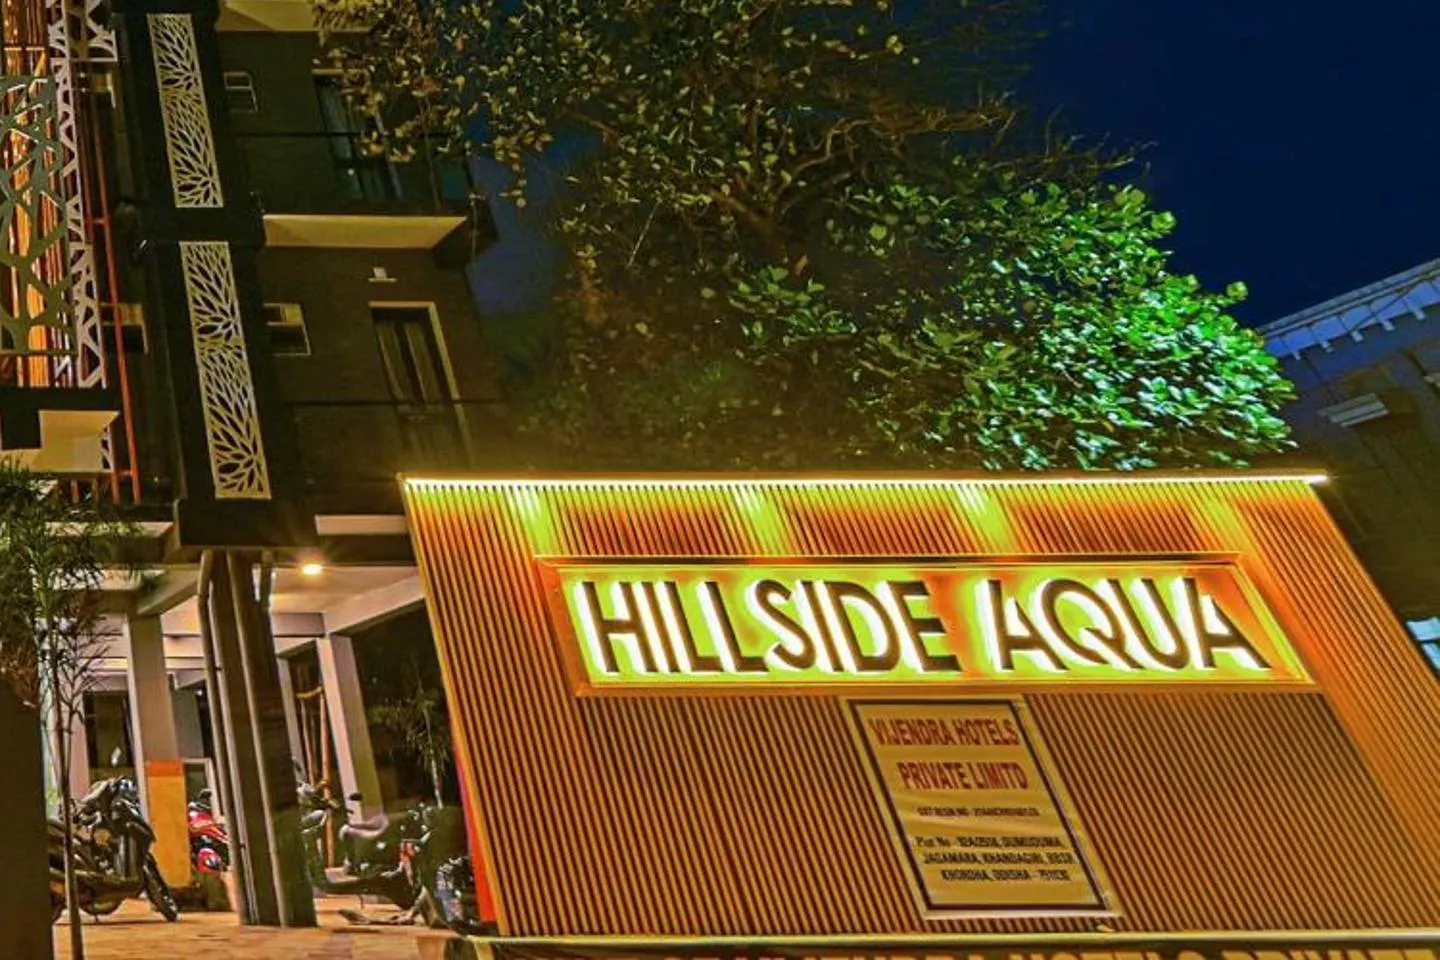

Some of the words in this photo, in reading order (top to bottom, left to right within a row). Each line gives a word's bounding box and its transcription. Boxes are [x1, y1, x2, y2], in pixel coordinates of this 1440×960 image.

[576, 578, 962, 673] HILLSIDE
[976, 577, 1272, 672] AQUA
[952, 718, 1020, 745] HOTELS
[896, 762, 972, 789] PRIVATE
